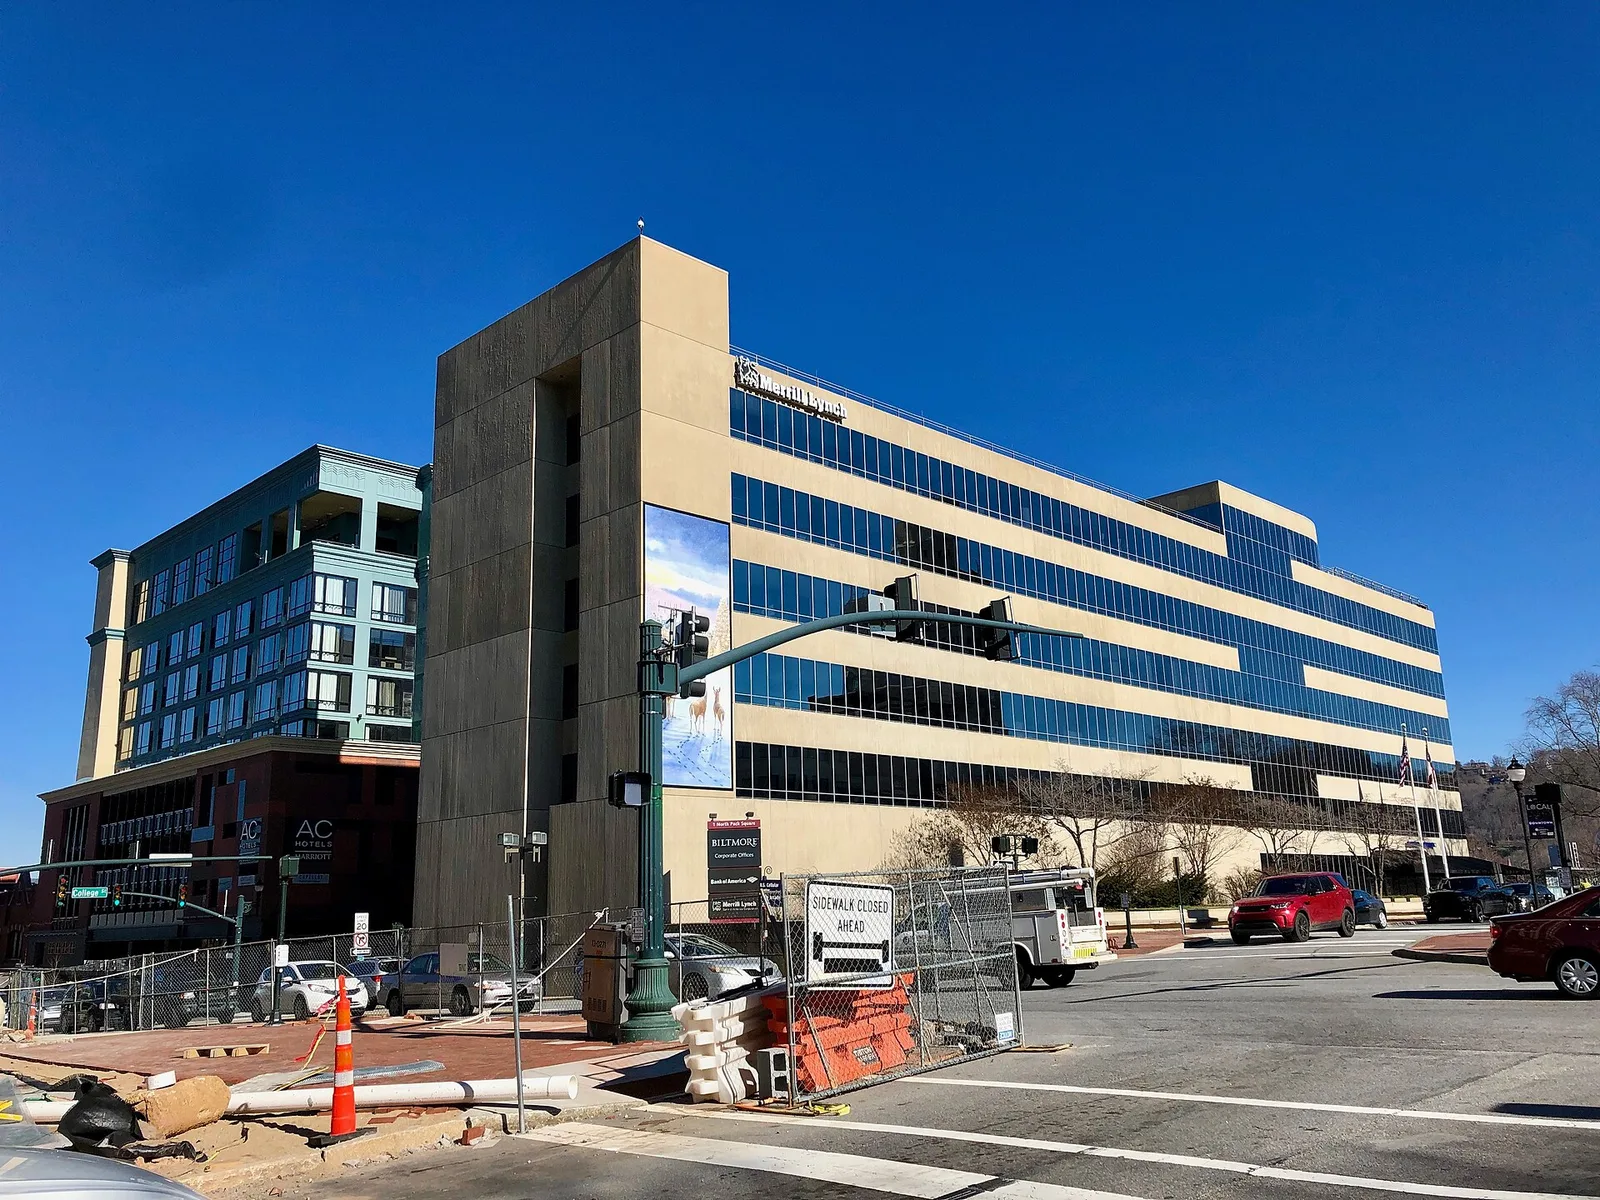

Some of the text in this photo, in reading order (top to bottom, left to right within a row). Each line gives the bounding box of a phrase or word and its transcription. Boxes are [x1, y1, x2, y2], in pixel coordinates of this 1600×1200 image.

[760, 373, 848, 417] Merrill Lynch
[240, 820, 258, 841] AC
[295, 819, 333, 839] AC
[294, 840, 333, 848] HOTELS
[711, 837, 758, 848] BILTMORE
[714, 851, 754, 860] Corporate Offices
[72, 889, 99, 897] College
[741, 900, 757, 908] Lynch
[812, 896, 889, 914] SIDEWALK CLOSED
[837, 919, 865, 933] AHEAD
